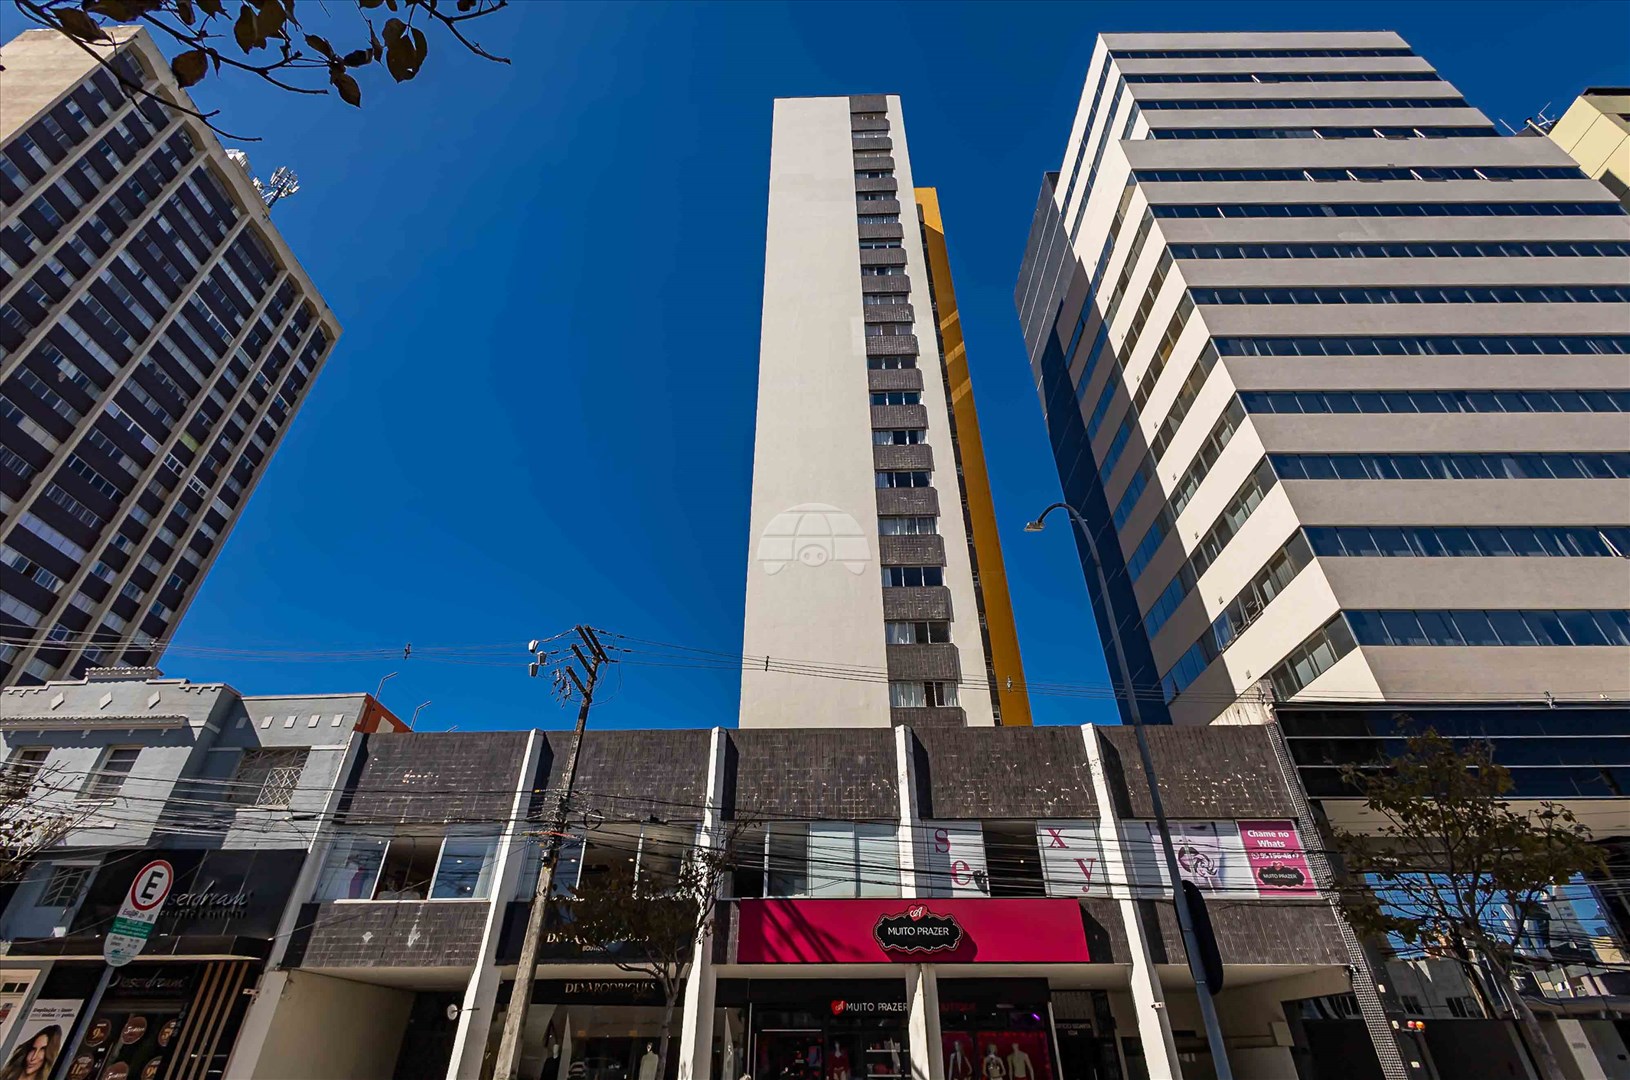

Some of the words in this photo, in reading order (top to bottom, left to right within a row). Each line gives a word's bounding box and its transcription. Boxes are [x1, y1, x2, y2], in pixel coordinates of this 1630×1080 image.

[1257, 840, 1286, 848] Whats
[141, 870, 164, 900] E
[887, 926, 916, 936] MUITO
[917, 926, 950, 936] PRAZER
[846, 1002, 875, 1012] MUITO
[878, 1002, 908, 1012] PRAZER
